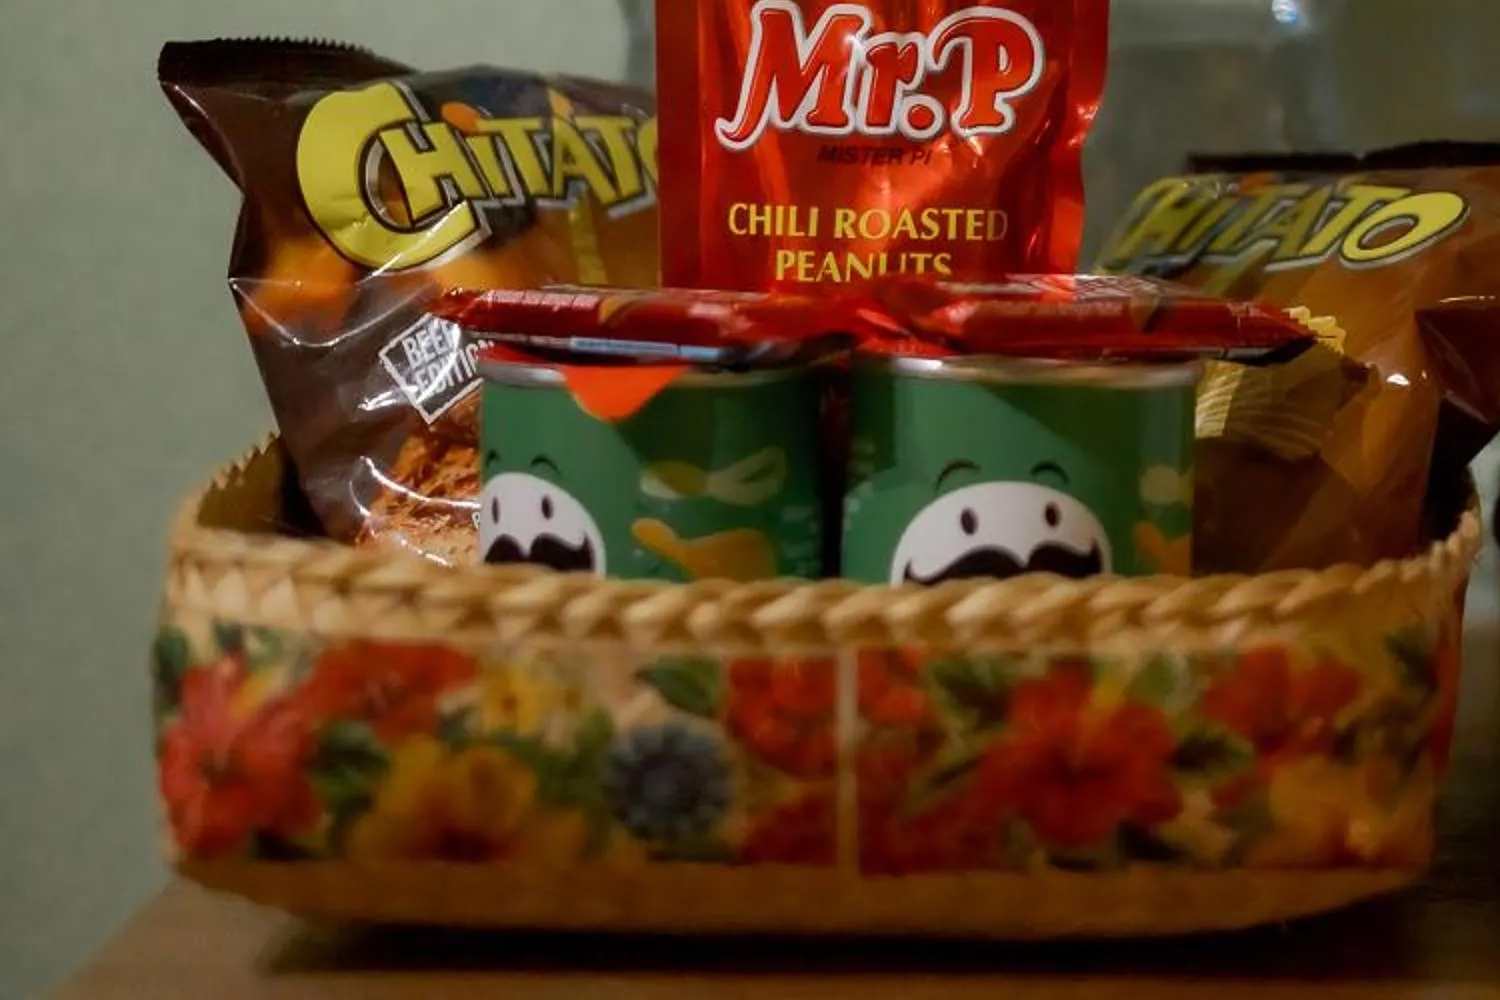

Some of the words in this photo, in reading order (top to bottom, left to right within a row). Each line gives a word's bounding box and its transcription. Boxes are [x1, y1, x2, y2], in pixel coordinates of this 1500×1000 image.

[818, 144, 904, 166] MISTER
[296, 80, 657, 272] CHITAT
[728, 203, 818, 238] CHILI
[834, 208, 1008, 242] ROASTED
[775, 250, 953, 284] PEANUTS
[414, 339, 495, 395] EDITIO
